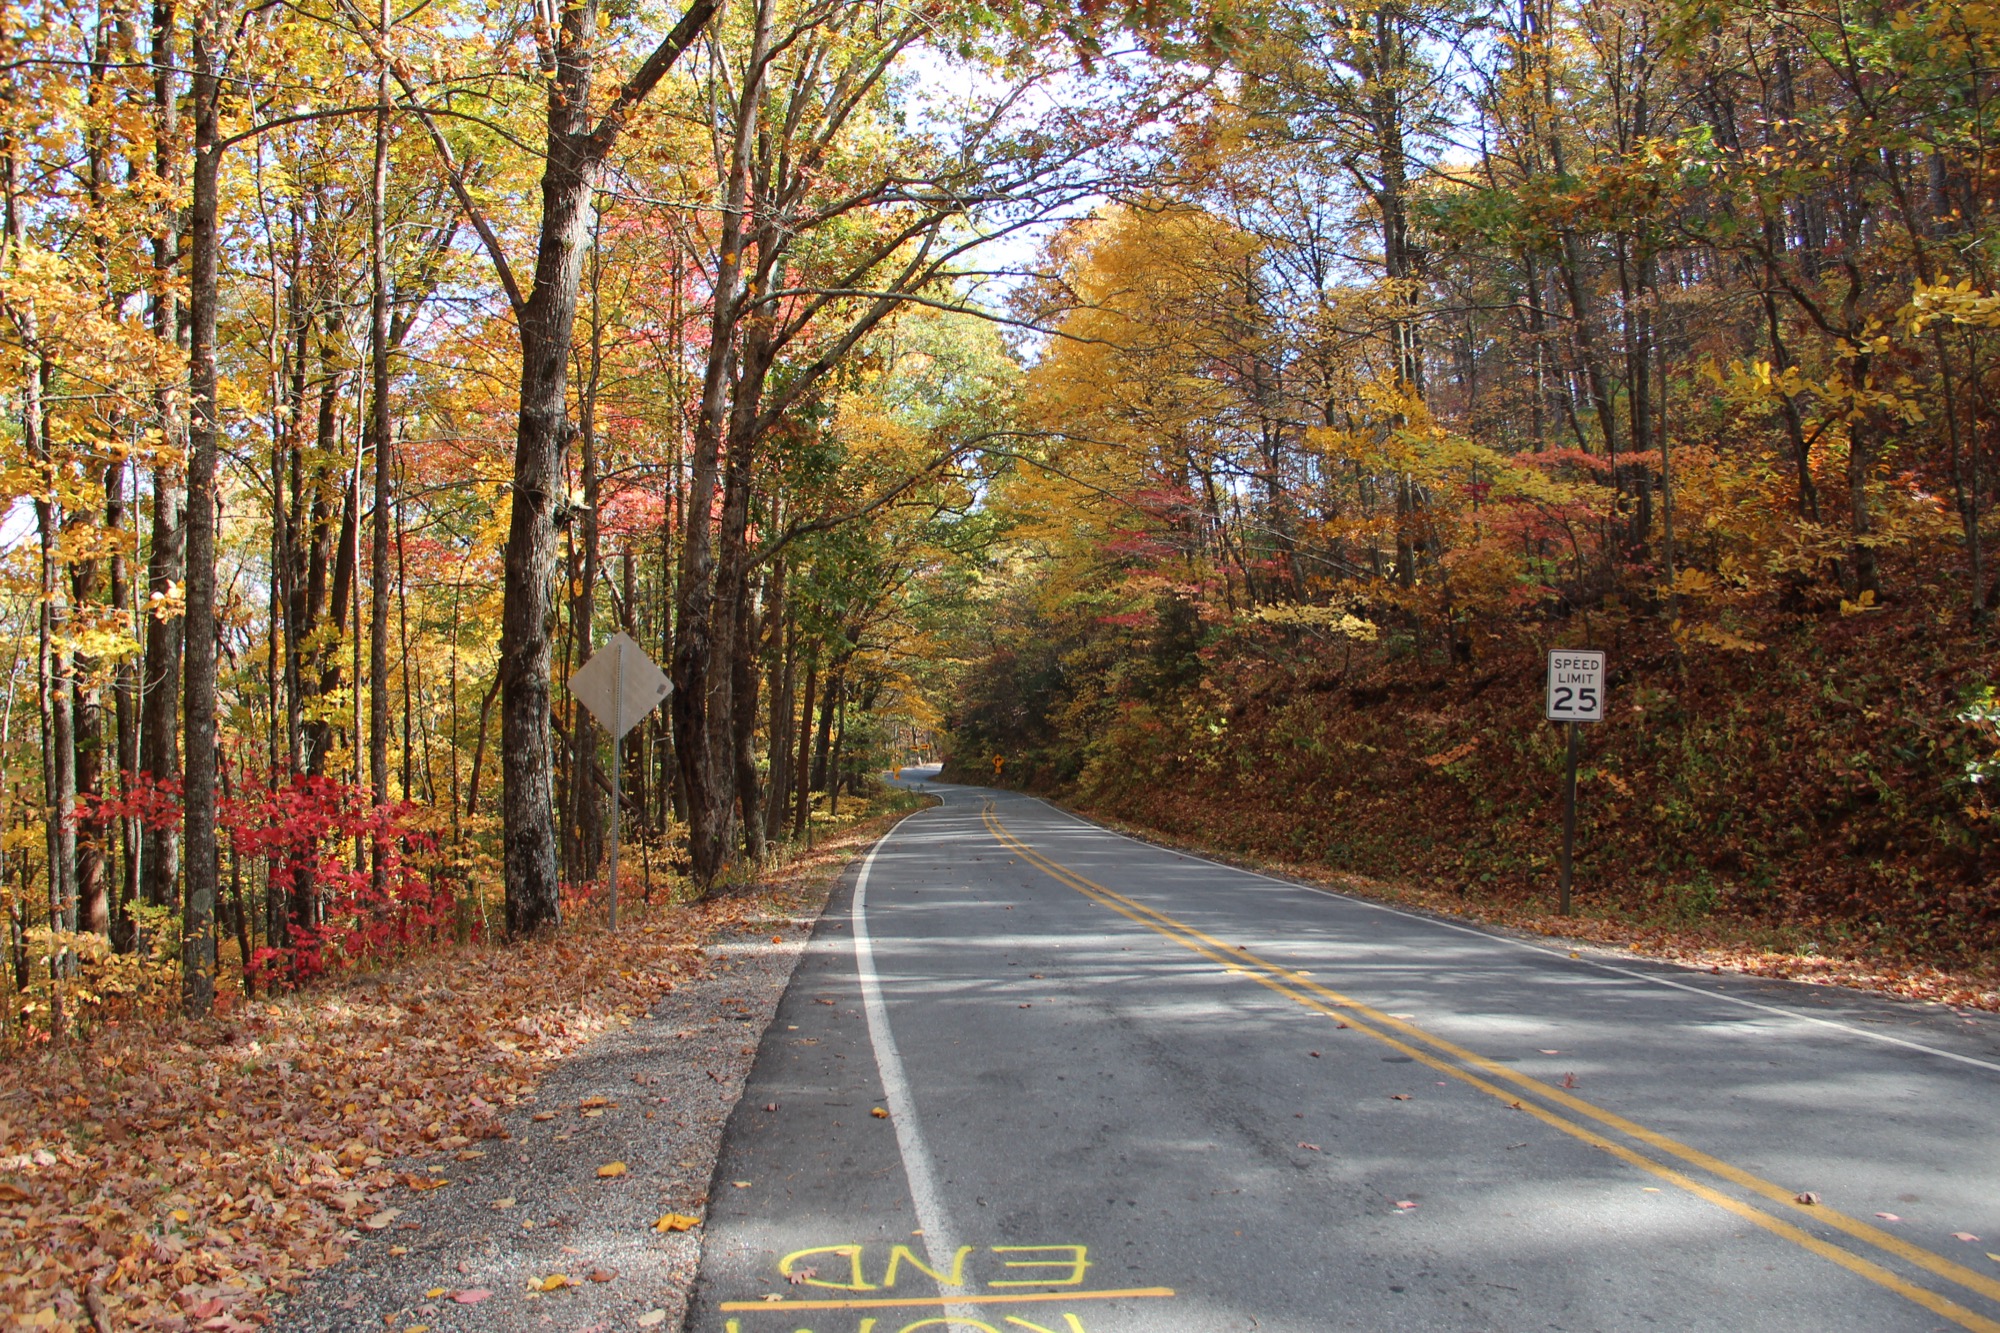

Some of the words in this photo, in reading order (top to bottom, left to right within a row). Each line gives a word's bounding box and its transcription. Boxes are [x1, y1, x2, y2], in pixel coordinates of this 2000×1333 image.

[1554, 658, 1600, 671] SPEED
[1558, 673, 1594, 684] LIMIT
[1553, 687, 1597, 712] 25
[777, 1243, 1092, 1290] END
